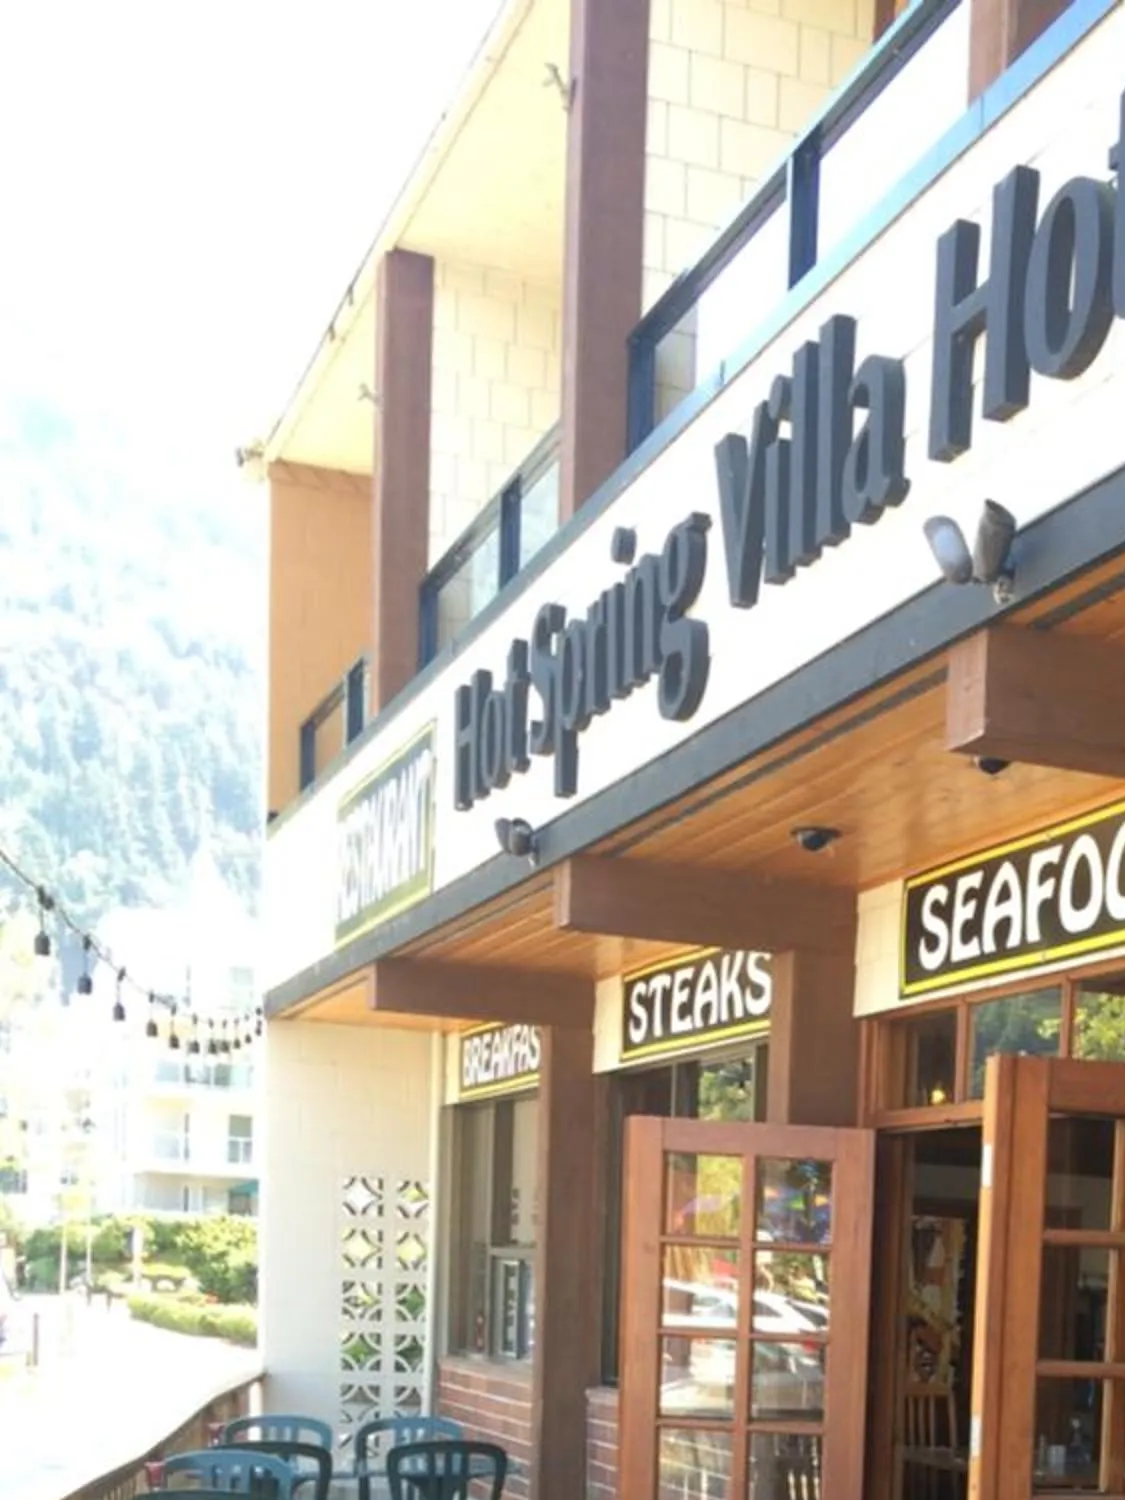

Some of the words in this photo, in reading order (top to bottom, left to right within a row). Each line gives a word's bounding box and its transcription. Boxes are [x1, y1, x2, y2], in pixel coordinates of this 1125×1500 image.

[454, 637, 531, 811] Hot
[529, 511, 712, 799] Spring
[715, 314, 911, 608] Villa
[628, 950, 773, 1044] STEAKS
[463, 1023, 541, 1087] BREAKFAS
